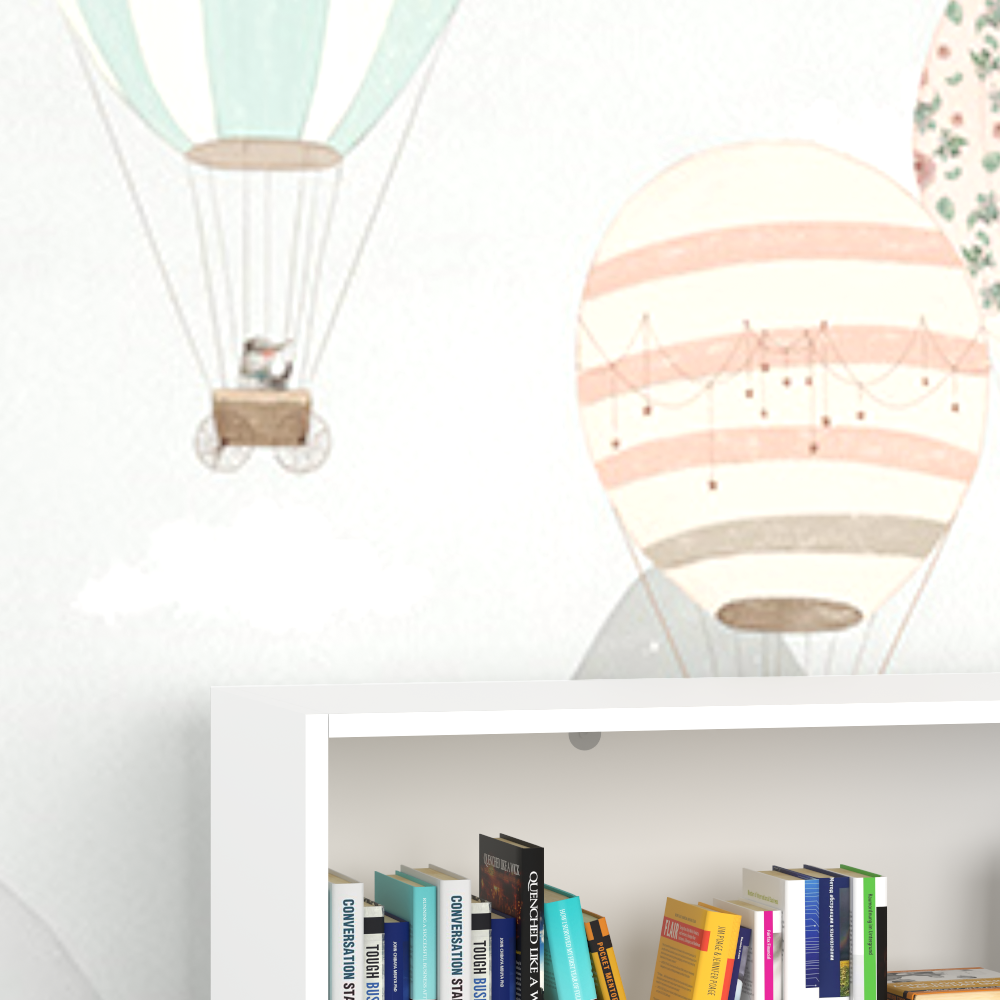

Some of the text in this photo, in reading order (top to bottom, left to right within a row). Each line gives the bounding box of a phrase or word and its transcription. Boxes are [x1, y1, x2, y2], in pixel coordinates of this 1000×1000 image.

[528, 870, 538, 944] QUENCHED
[342, 898, 355, 980] CONVERSATION
[450, 895, 462, 976] CONVERSATION
[664, 920, 680, 940] FLAIR
[366, 944, 380, 979] TOUGH
[473, 940, 487, 974] TOUGH
[530, 948, 538, 974] LIKE
[596, 942, 610, 970] POCKET
[710, 957, 720, 980] JENNIFER
[530, 976, 538, 987] A
